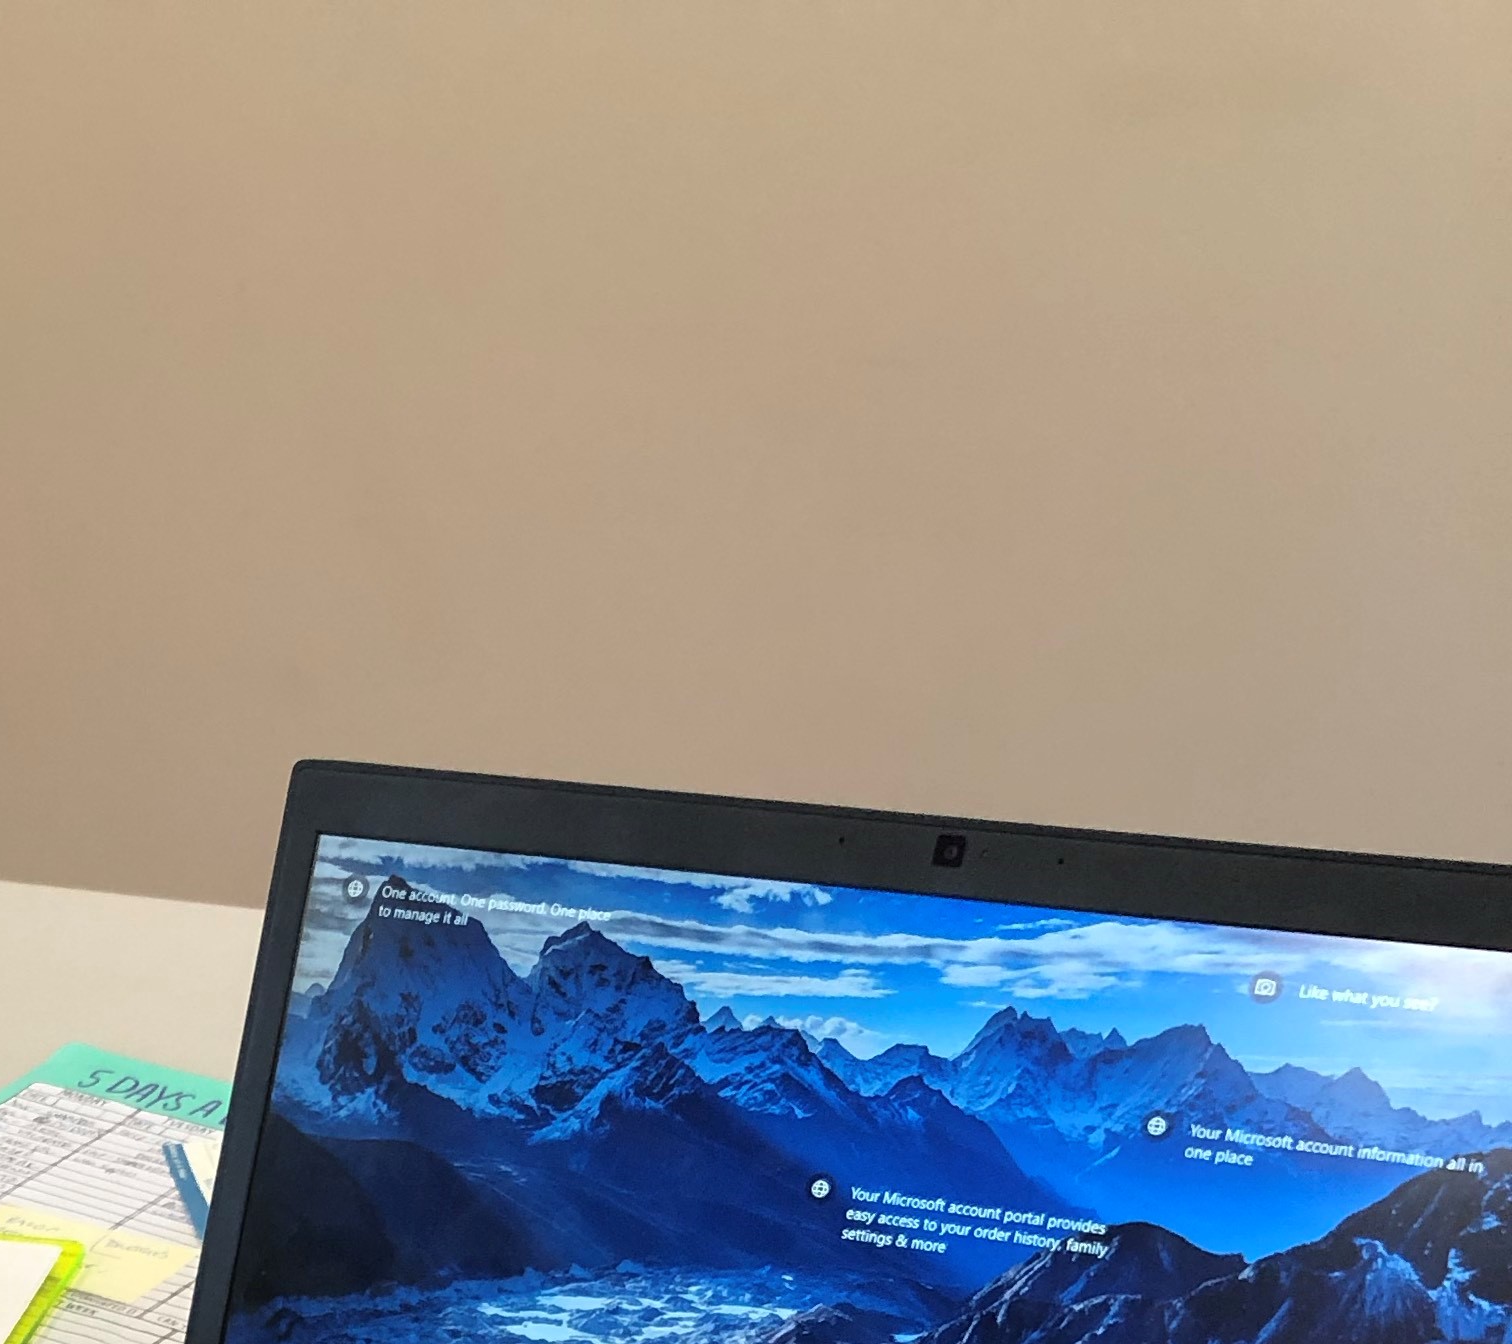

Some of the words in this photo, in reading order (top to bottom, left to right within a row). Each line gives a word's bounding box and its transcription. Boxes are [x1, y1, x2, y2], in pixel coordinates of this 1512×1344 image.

[379, 905, 390, 917] to
[394, 909, 439, 925] manage
[443, 911, 452, 924] it
[454, 914, 468, 926] all
[382, 886, 406, 900] One
[461, 894, 485, 908] One
[550, 903, 574, 918] One
[579, 907, 612, 922] place
[1299, 984, 1327, 1001] Like
[1332, 987, 1367, 1005] what
[1370, 992, 1400, 1009] you
[77, 1069, 115, 1088] 5
[105, 1076, 195, 1112] DAYS
[189, 1099, 223, 1118] A
[1185, 1147, 1211, 1161] one
[1214, 1149, 1253, 1167] place
[1190, 1124, 1223, 1140] Your
[1225, 1128, 1293, 1150] Microsoft
[1296, 1138, 1353, 1159] account
[1357, 1145, 1444, 1170] information
[1446, 1156, 1465, 1171] all
[1469, 1159, 1484, 1173] in
[851, 1187, 880, 1202] Your
[883, 1190, 945, 1212] Microsoft
[948, 1203, 1001, 1221] account
[1003, 1210, 1045, 1228] portal
[1047, 1217, 1107, 1236] provides
[841, 1229, 893, 1248] settings
[896, 1235, 908, 1248] &
[911, 1241, 947, 1254] more
[846, 1208, 875, 1225] easy
[878, 1215, 920, 1230] access
[923, 1218, 937, 1232] to
[939, 1222, 971, 1237] your
[973, 1225, 1010, 1242] order
[1013, 1231, 1062, 1253] history,
[1066, 1237, 1108, 1259] family
